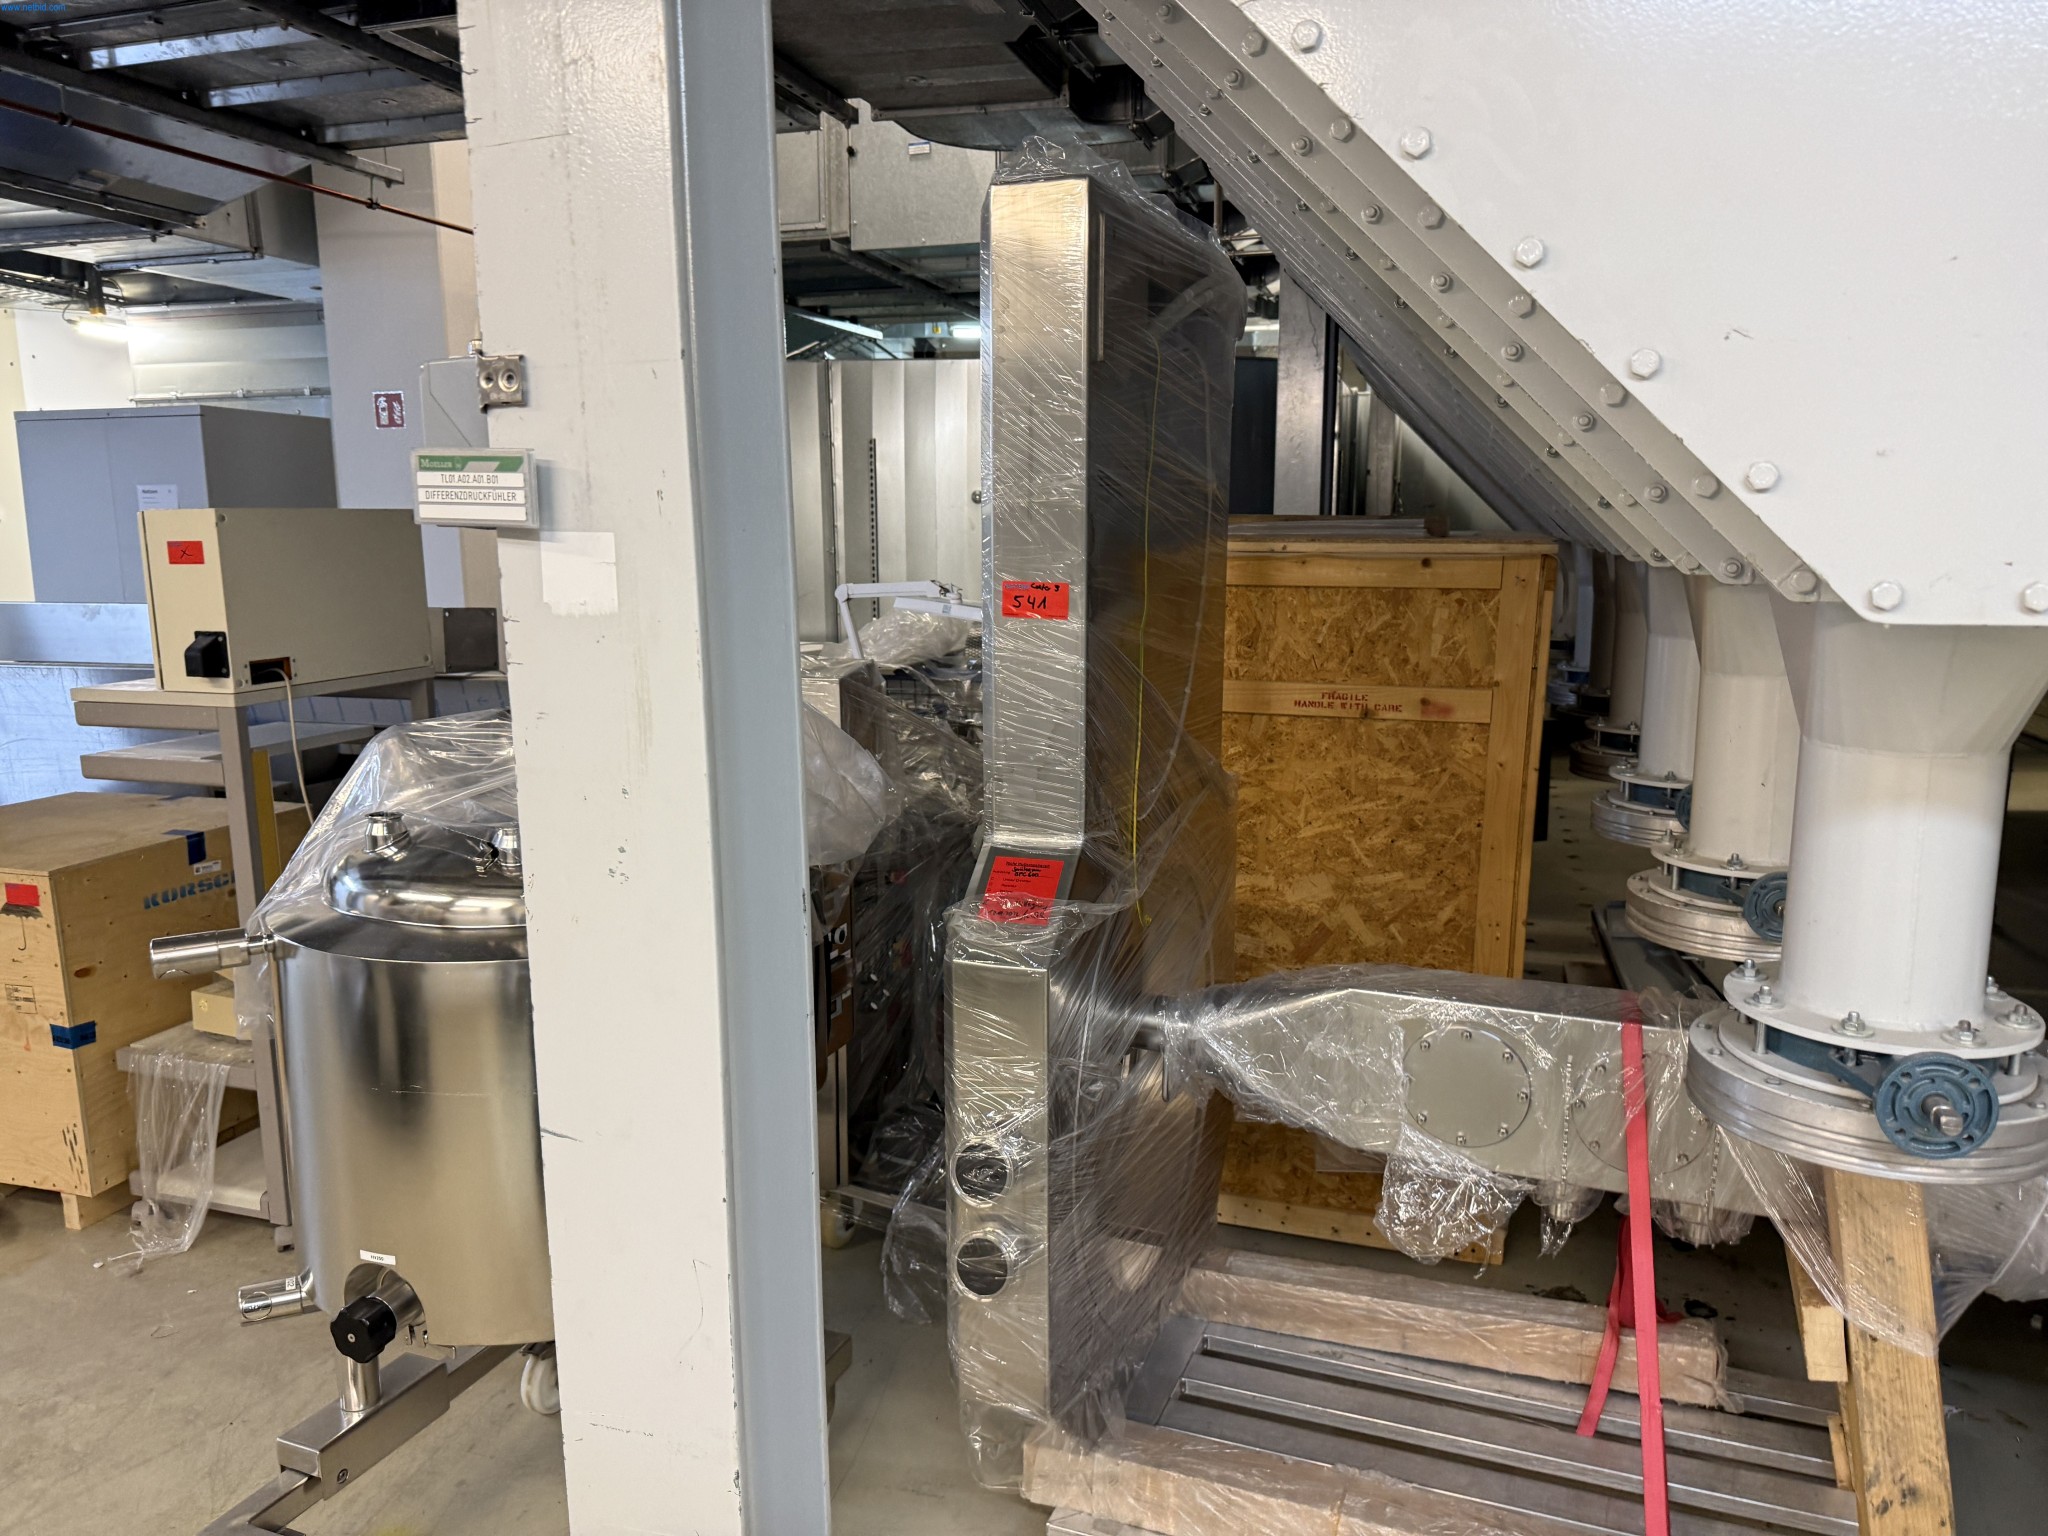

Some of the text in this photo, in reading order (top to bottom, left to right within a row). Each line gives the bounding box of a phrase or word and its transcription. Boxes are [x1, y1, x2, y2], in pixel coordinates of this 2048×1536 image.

[1012, 595, 1047, 609] 541
[1321, 691, 1369, 701] FRAGILE
[1294, 700, 1403, 713] HANDLE WITH CARE
[144, 870, 235, 910] KORSC
